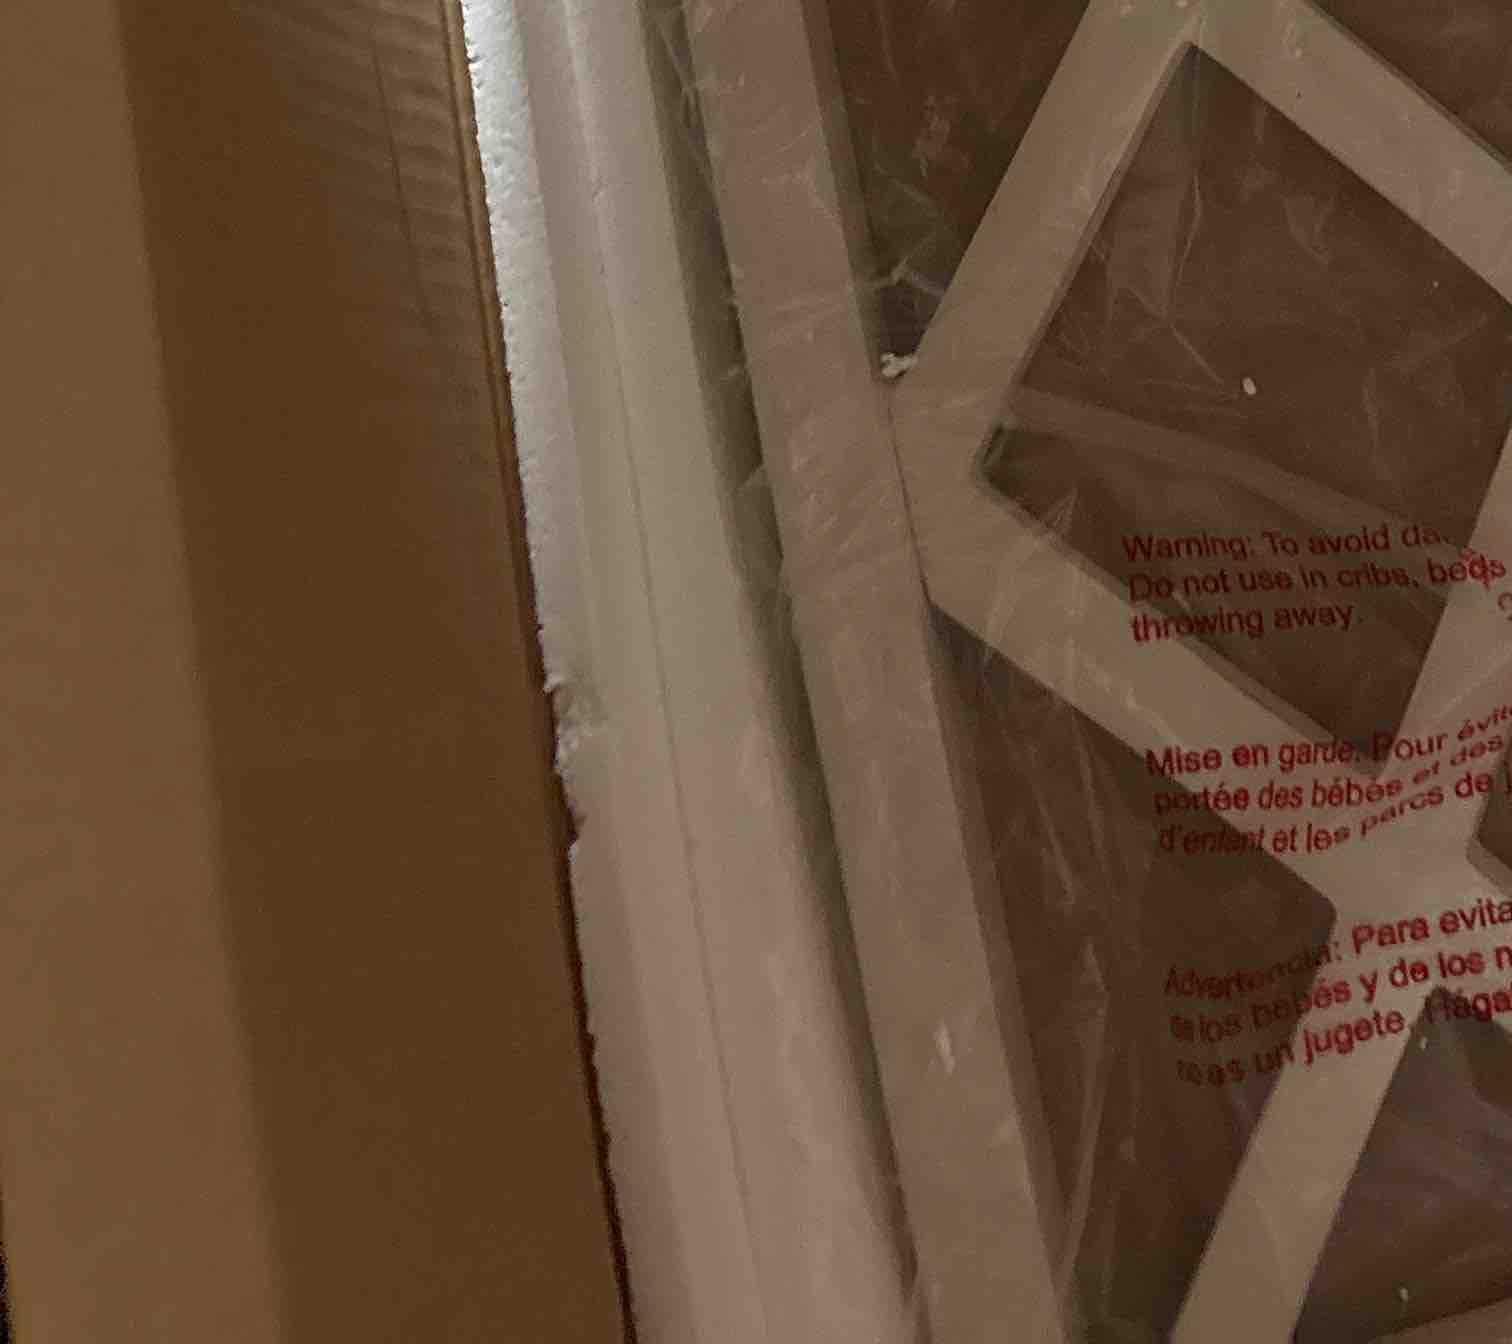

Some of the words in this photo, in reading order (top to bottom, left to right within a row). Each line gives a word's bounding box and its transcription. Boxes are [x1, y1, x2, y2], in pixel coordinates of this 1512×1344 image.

[1120, 529, 1252, 562] Warning:
[1262, 529, 1299, 556] To
[1308, 523, 1391, 555] avoid
[1127, 572, 1174, 603] Do
[1183, 568, 1233, 596] not
[1240, 570, 1294, 594] use
[1300, 564, 1329, 592] in
[1335, 560, 1420, 592] cribs,
[1129, 605, 1264, 643] throwing
[1144, 746, 1222, 778] Mise
[1232, 746, 1269, 768] en
[1370, 730, 1449, 762] Pour
[1257, 781, 1302, 810] des
[1412, 762, 1440, 783] et
[1272, 826, 1297, 854] et
[1306, 822, 1350, 854] les
[1454, 769, 1493, 801] de
[1352, 913, 1430, 955] Para
[1360, 971, 1378, 1003] y
[1388, 958, 1430, 988] de
[1437, 946, 1486, 978] los
[1252, 1038, 1294, 1074] un
